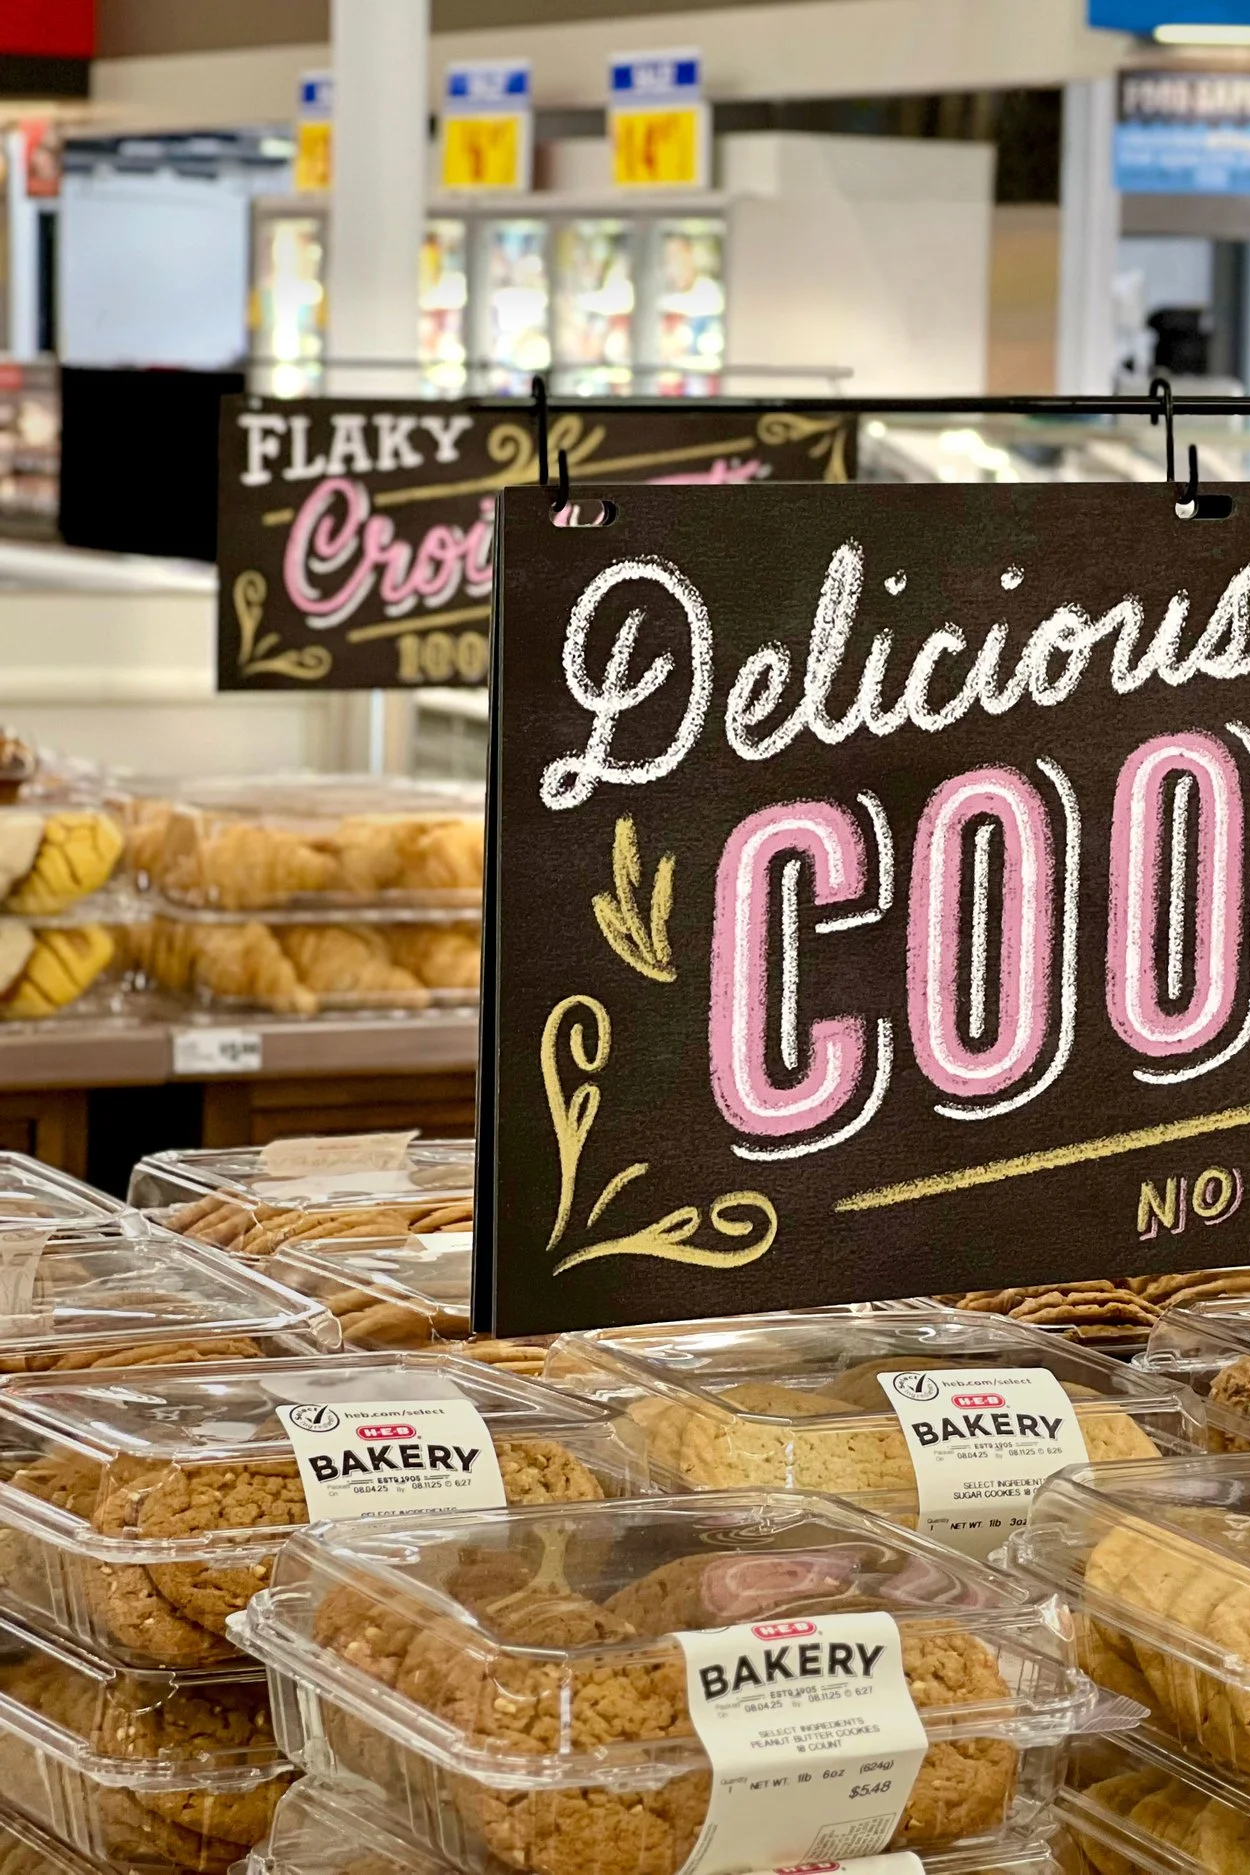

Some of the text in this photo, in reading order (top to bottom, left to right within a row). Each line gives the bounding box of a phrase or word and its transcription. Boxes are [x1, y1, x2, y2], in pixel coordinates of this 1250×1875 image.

[239, 414, 474, 484] FLAKY
[1136, 1166, 1243, 1240] NO
[942, 1378, 1032, 1388] heb.com/select
[344, 1408, 445, 1419] heb.com/select
[912, 1413, 1065, 1447] BAKERY
[308, 1444, 481, 1483] BAKERY
[400, 1475, 421, 1483] 1905
[964, 1481, 994, 1489] SELECT
[954, 1491, 982, 1500] SUGAR
[985, 1489, 1021, 1498] COOKIES
[950, 1522, 966, 1530] NET
[699, 1642, 887, 1702] BAKERY
[751, 1724, 881, 1748] PEANUT BUTTER COOKIES
[759, 1717, 864, 1739] SELECT INGREDIENTS
[809, 1740, 842, 1752] COUNT
[750, 1781, 769, 1791] NET
[823, 1768, 845, 1780] 6oz
[849, 1780, 892, 1799] $5.48
